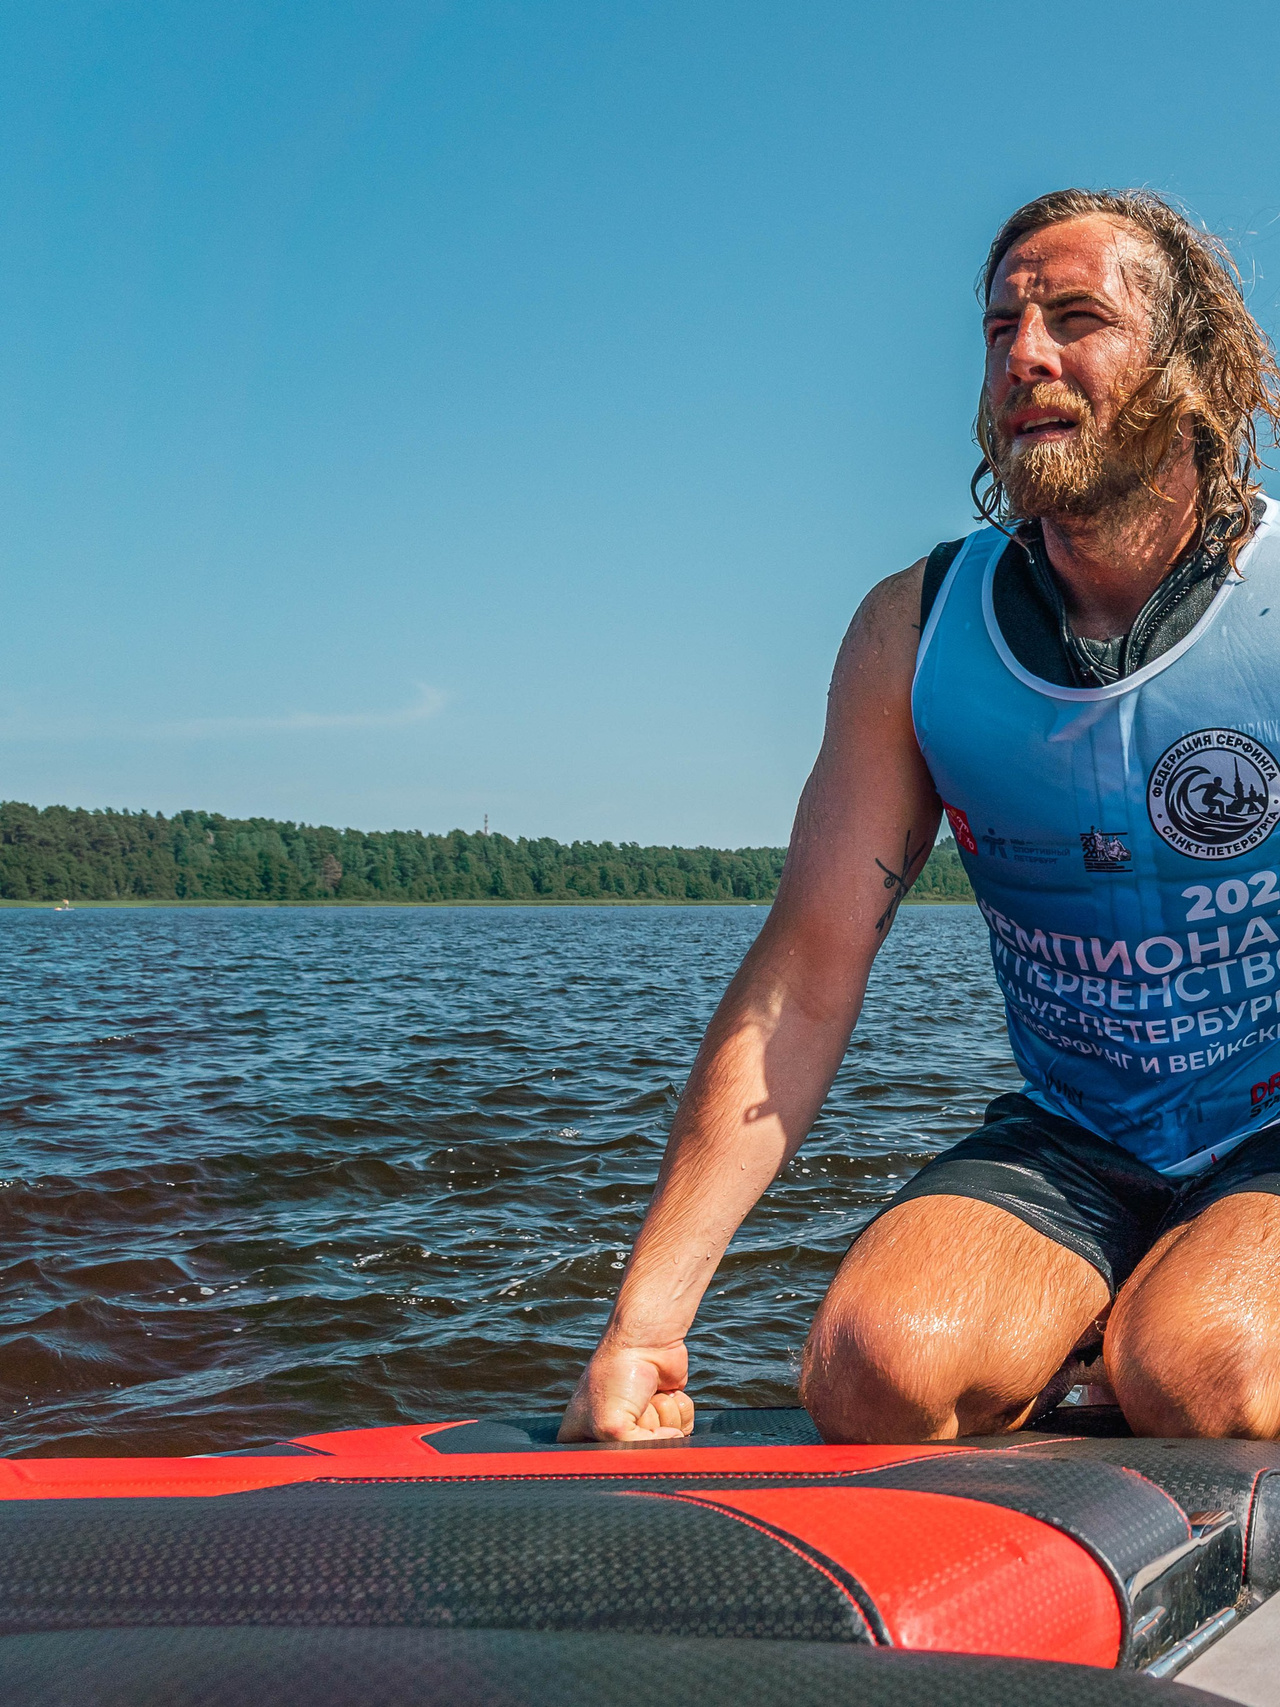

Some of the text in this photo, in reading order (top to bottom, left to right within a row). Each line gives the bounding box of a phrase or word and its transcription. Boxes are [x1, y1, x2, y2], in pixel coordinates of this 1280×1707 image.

[1152, 734, 1278, 798] ФЕДЕРАЦИЯ СЕРФИНГА
[1162, 811, 1279, 856] САНКТ-ПЕТЕРБУРГА
[1141, 1057, 1161, 1074] И
